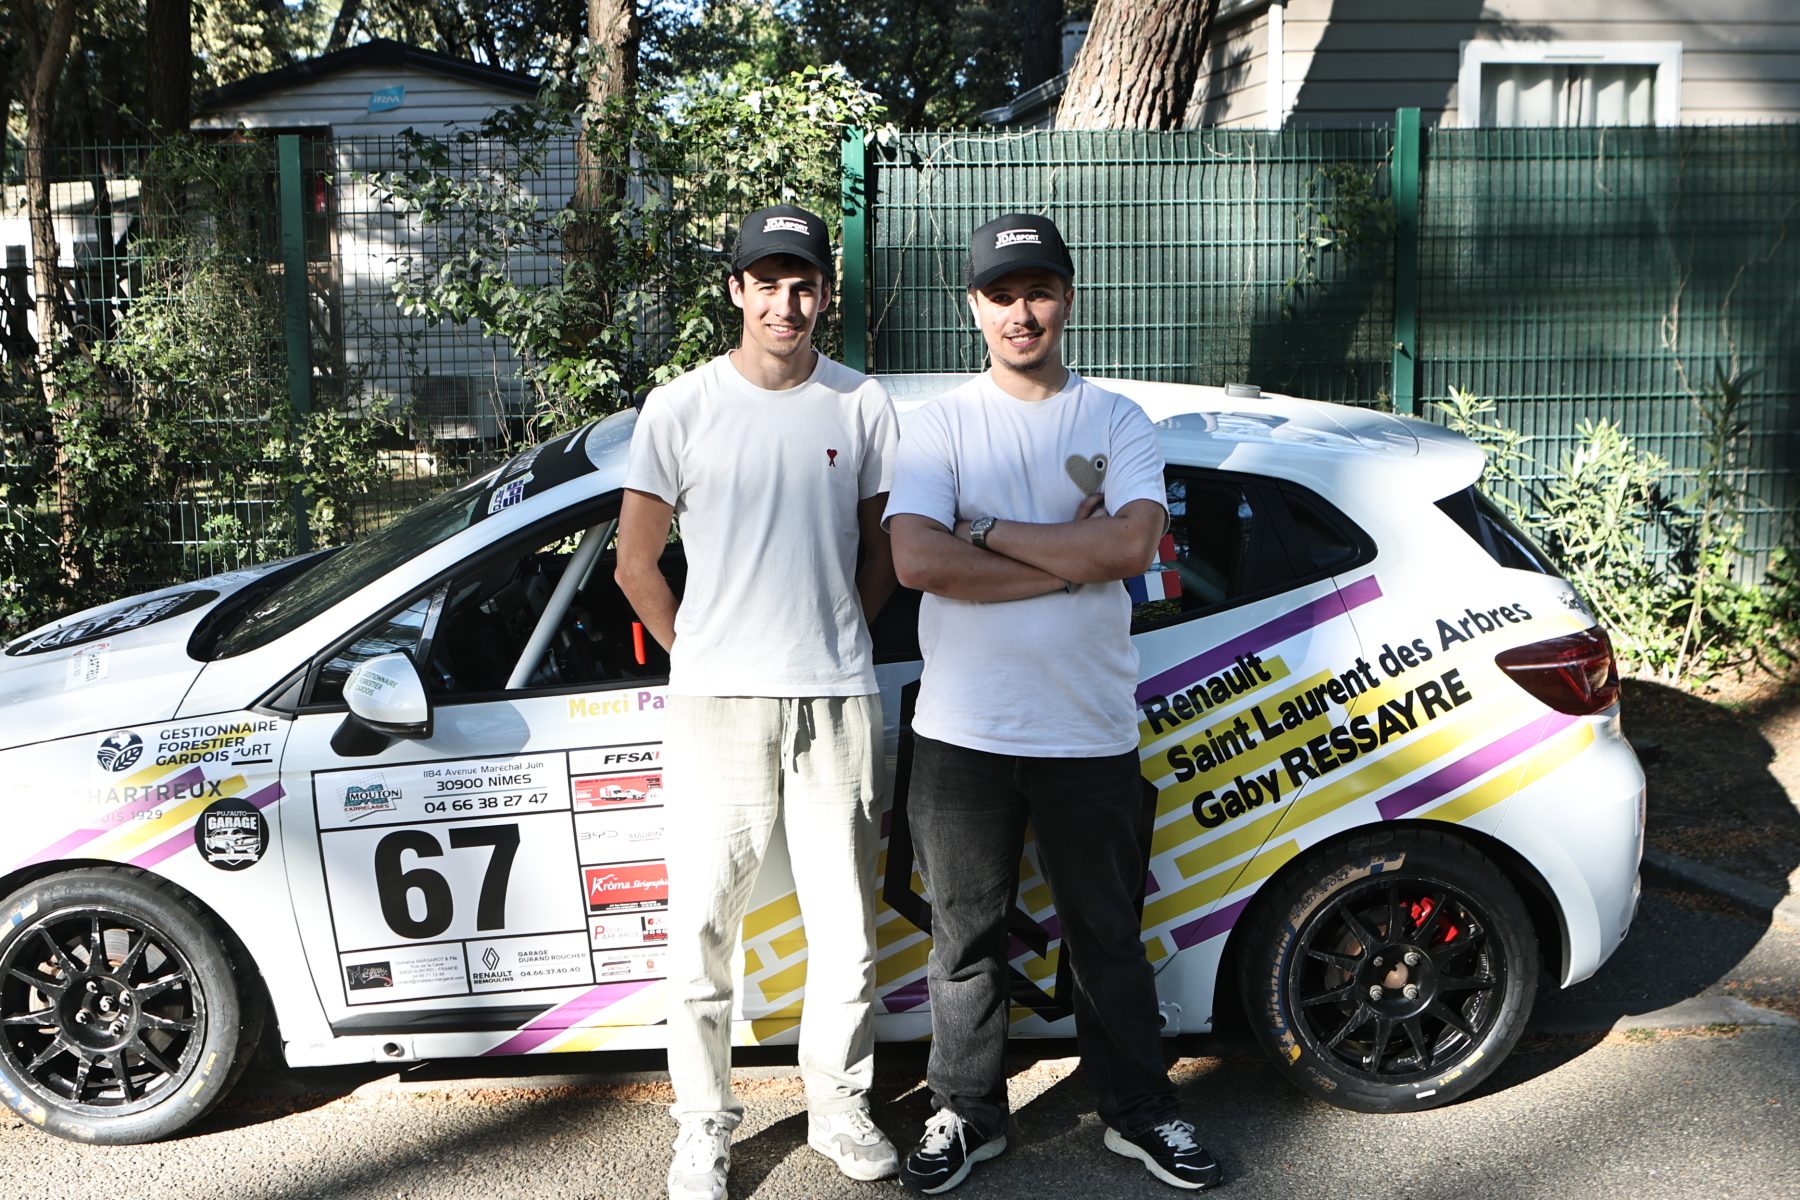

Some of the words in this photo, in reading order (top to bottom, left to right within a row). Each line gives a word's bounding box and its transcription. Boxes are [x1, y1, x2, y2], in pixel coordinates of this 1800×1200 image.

[1142, 652, 1272, 735] Renault
[1166, 717, 1257, 783] Saint
[1251, 657, 1380, 741] Laurent
[1378, 638, 1433, 678] des
[1436, 603, 1533, 652] Arbres
[569, 693, 629, 718] Merci
[638, 691, 669, 711] Pa
[160, 720, 278, 740] GESTIONNAIRE
[157, 737, 245, 753] FORESTIER
[1192, 769, 1281, 828] Gaby
[1280, 667, 1473, 788] RESSAYRE
[156, 751, 229, 766] GARDOIS
[604, 751, 653, 765] FFSA
[445, 768, 478, 777] Avenue
[526, 761, 544, 770] Juin
[436, 778, 483, 791] 30900
[488, 774, 532, 787] NÎMES
[351, 789, 399, 801] MOUTON
[424, 801, 447, 813] 04
[452, 799, 473, 811] 66
[478, 797, 498, 809] 38
[504, 795, 522, 807] 27
[528, 793, 548, 804] 47
[130, 809, 162, 821] 1929
[207, 817, 257, 830] GARAGE
[374, 823, 521, 939] 67
[518, 949, 548, 957] GARAGE
[473, 970, 512, 979] RENAULT
